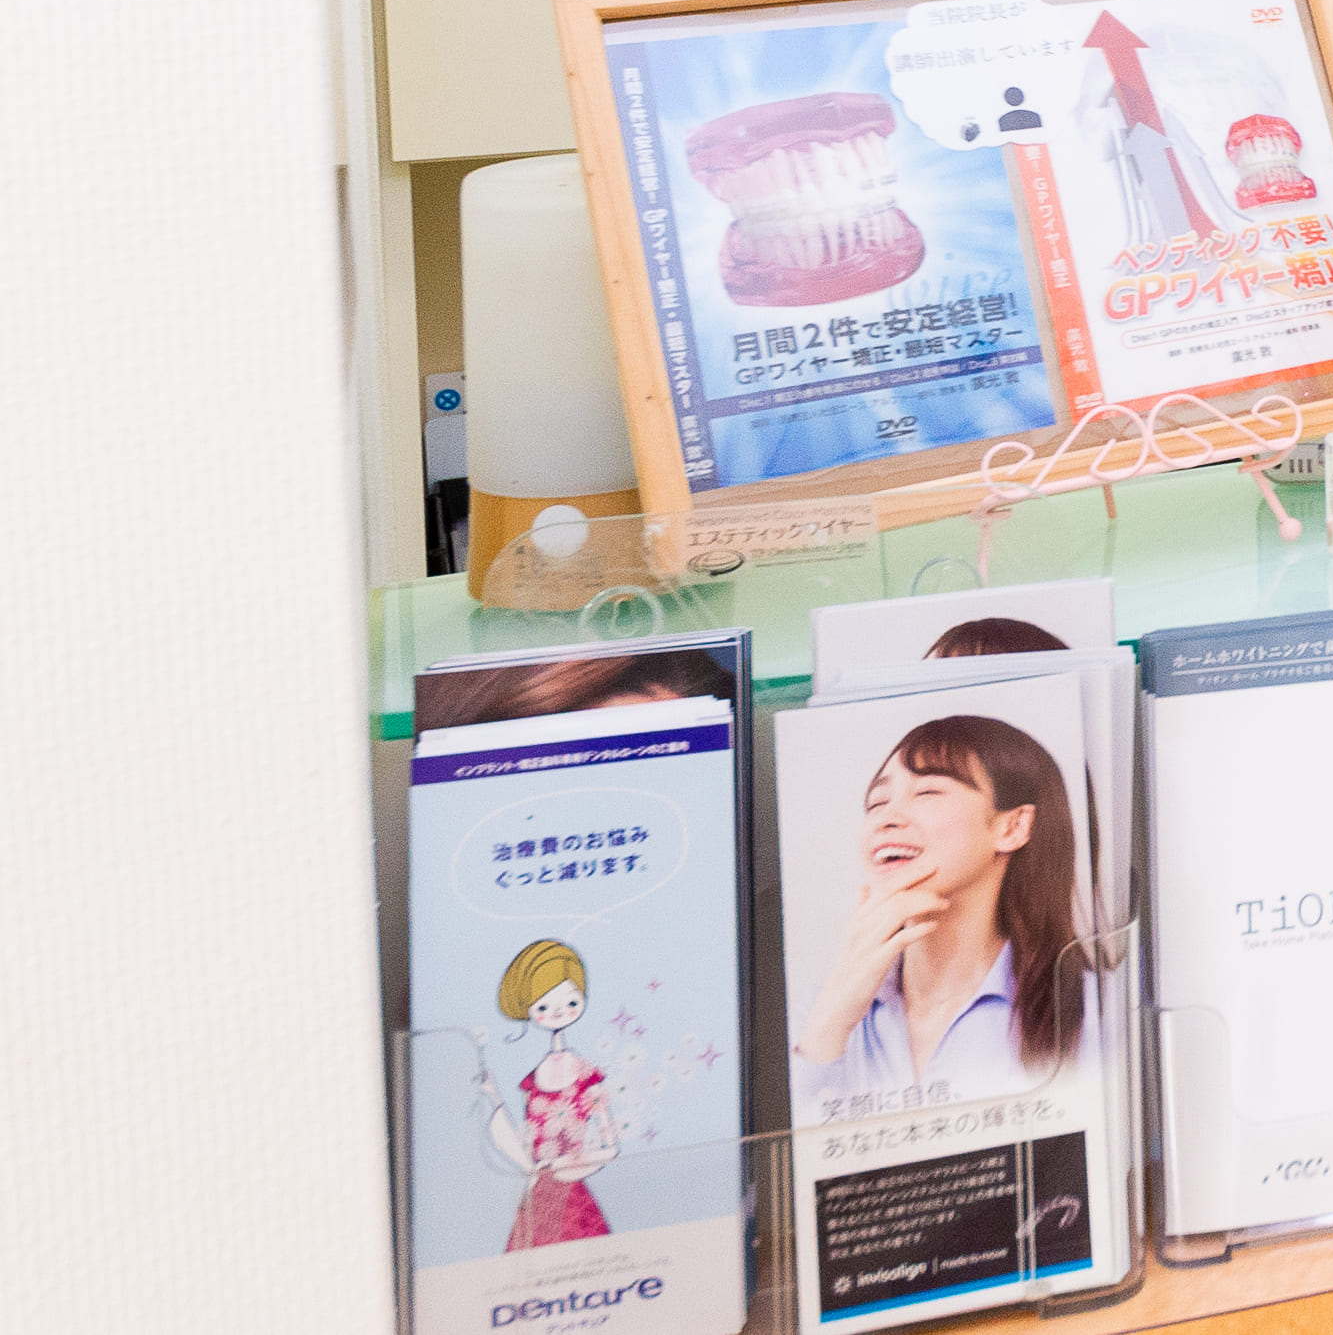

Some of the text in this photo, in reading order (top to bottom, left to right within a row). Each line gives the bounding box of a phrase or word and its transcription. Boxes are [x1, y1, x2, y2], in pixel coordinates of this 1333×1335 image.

[926, 1, 1028, 27] 当院院長が
[1251, 6, 1284, 24] DVD
[875, 415, 919, 440] DVD
[688, 520, 873, 547] エステティックワイヤー
[491, 825, 651, 863] 治療費のお悩み
[493, 853, 650, 890] ぐっと減ります。
[821, 1099, 1066, 1160] あなた本来の輝きを。
[490, 1276, 664, 1329] Dentcure
